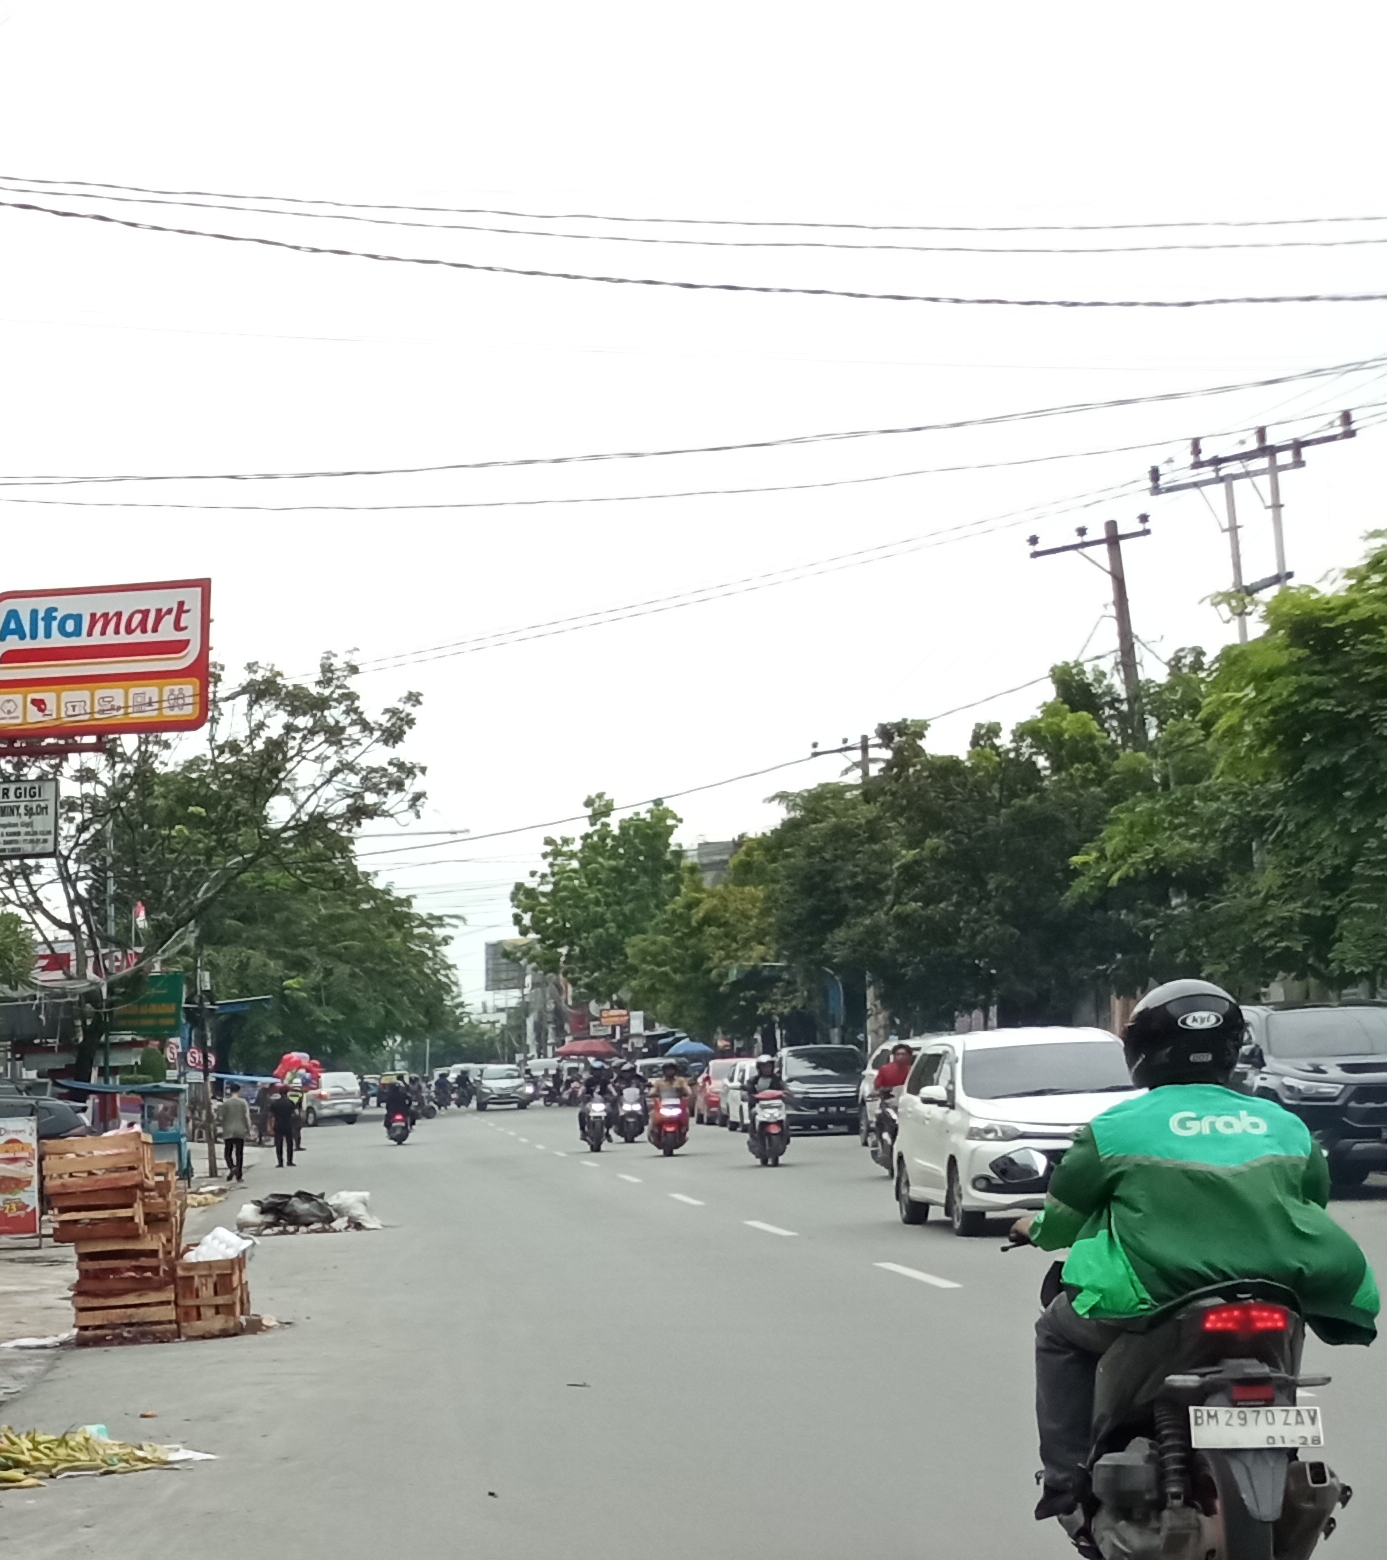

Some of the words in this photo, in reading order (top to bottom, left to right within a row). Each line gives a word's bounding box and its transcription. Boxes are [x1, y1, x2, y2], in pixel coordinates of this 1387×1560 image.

[14, 785, 42, 799] GIGI
[1169, 1110, 1267, 1136] Grab
[1193, 1408, 1219, 1426] BM
[1225, 1409, 1276, 1426] 2970
[1280, 1408, 1318, 1426] ZAV
[1267, 1436, 1322, 1446] 01-28
